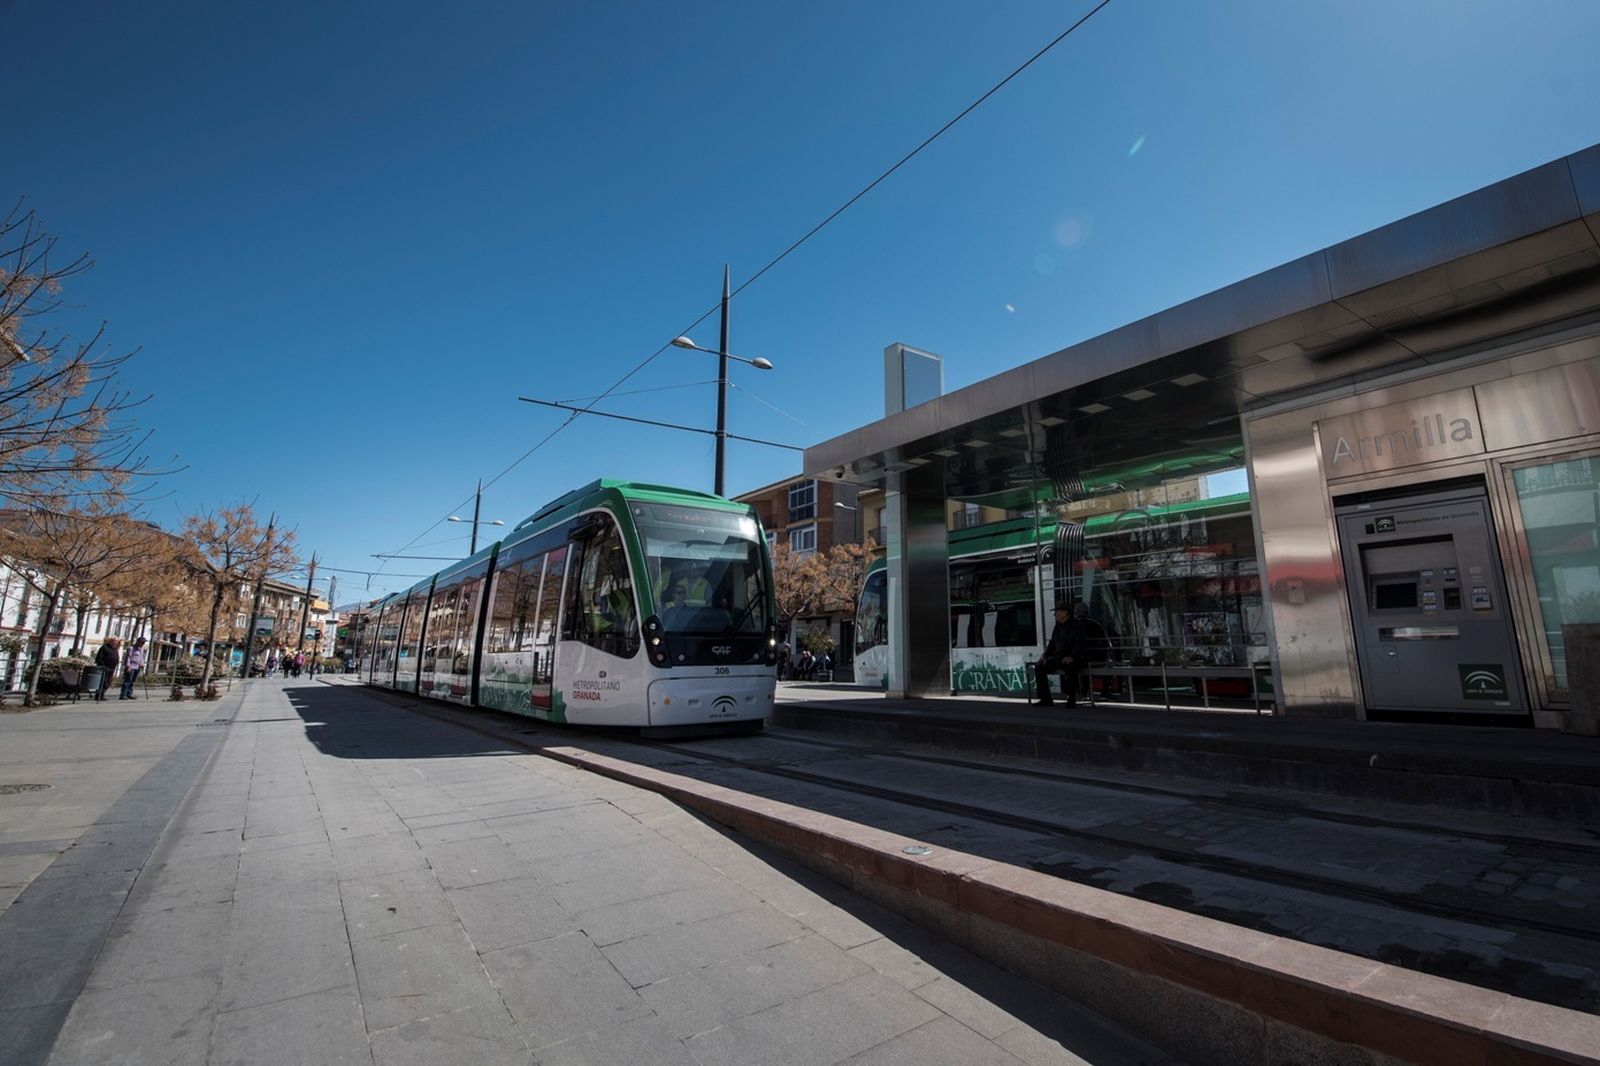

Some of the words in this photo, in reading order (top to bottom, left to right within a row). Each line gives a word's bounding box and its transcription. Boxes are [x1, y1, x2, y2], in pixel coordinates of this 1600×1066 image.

[1332, 412, 1474, 465] Armilla
[714, 666, 730, 676] 306
[958, 664, 1037, 693] GRANAD
[573, 680, 621, 692] METROPOLITANO
[573, 690, 602, 702] GRANADA
